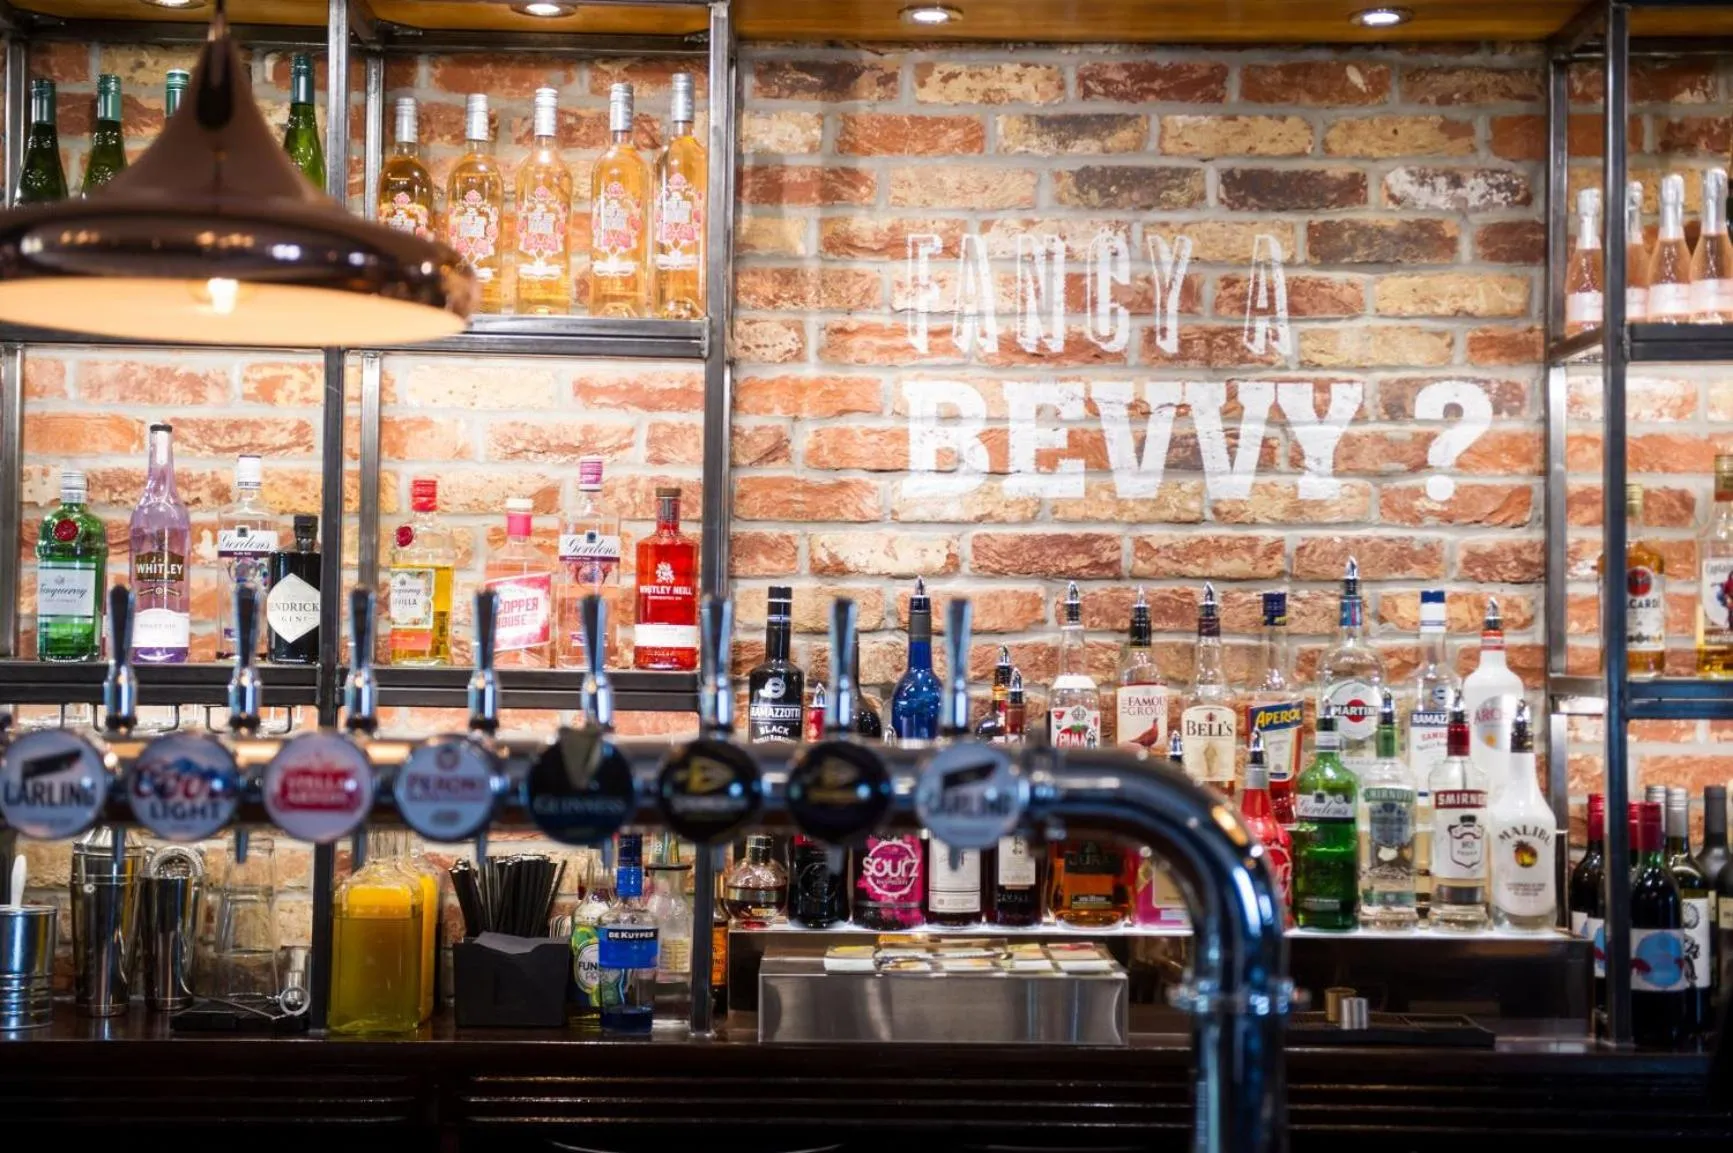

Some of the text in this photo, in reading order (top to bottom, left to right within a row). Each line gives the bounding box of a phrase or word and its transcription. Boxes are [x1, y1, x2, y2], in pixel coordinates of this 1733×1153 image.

[906, 231, 1292, 356] FANCY A
[901, 380, 1364, 500] BEVVY
[136, 563, 184, 575] WHITLEY
[1186, 719, 1233, 737] BELL'S
[1256, 708, 1302, 728] APEROL
[759, 725, 789, 735] BLACK
[150, 800, 221, 821] LIGHT
